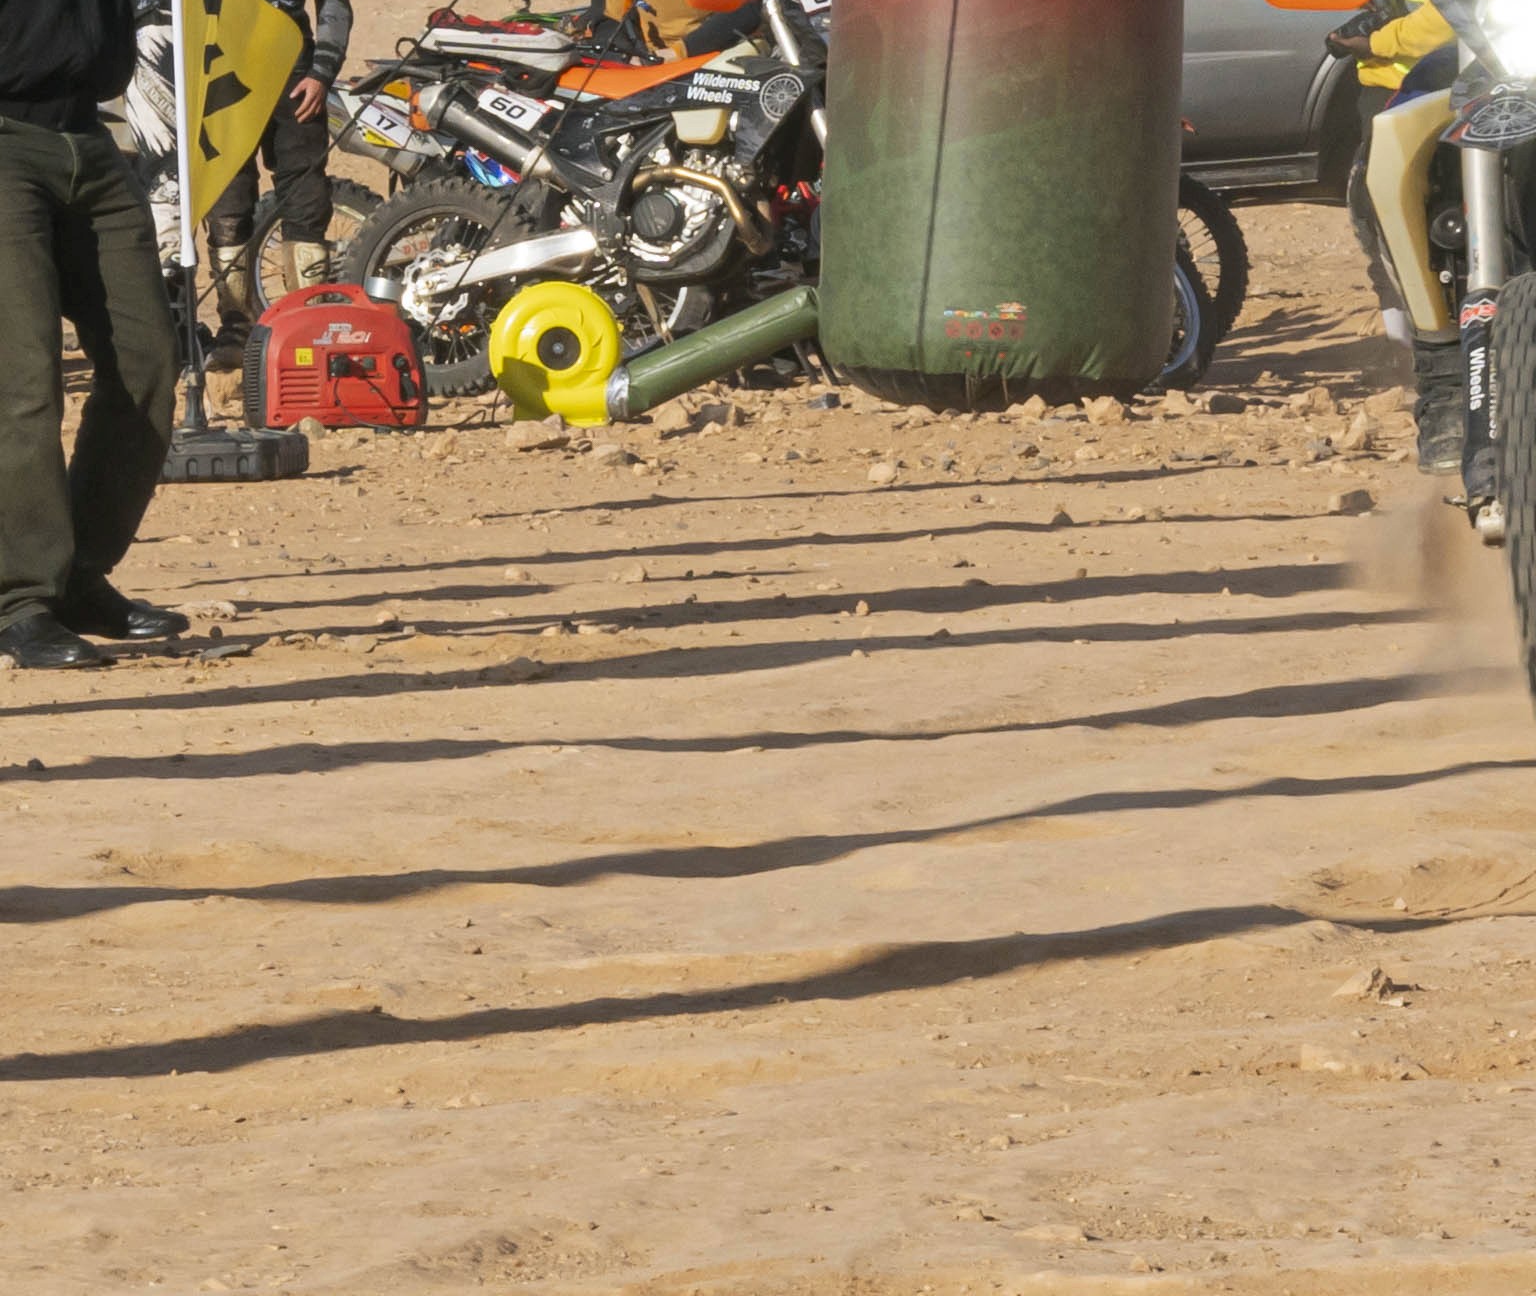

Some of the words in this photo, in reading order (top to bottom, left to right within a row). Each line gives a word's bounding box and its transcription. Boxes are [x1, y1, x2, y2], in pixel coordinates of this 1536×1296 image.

[692, 71, 761, 92] Wilderness
[686, 85, 734, 105] Wheels
[489, 95, 528, 120] 60
[374, 114, 399, 131] 17
[1469, 346, 1487, 411] Wheels
